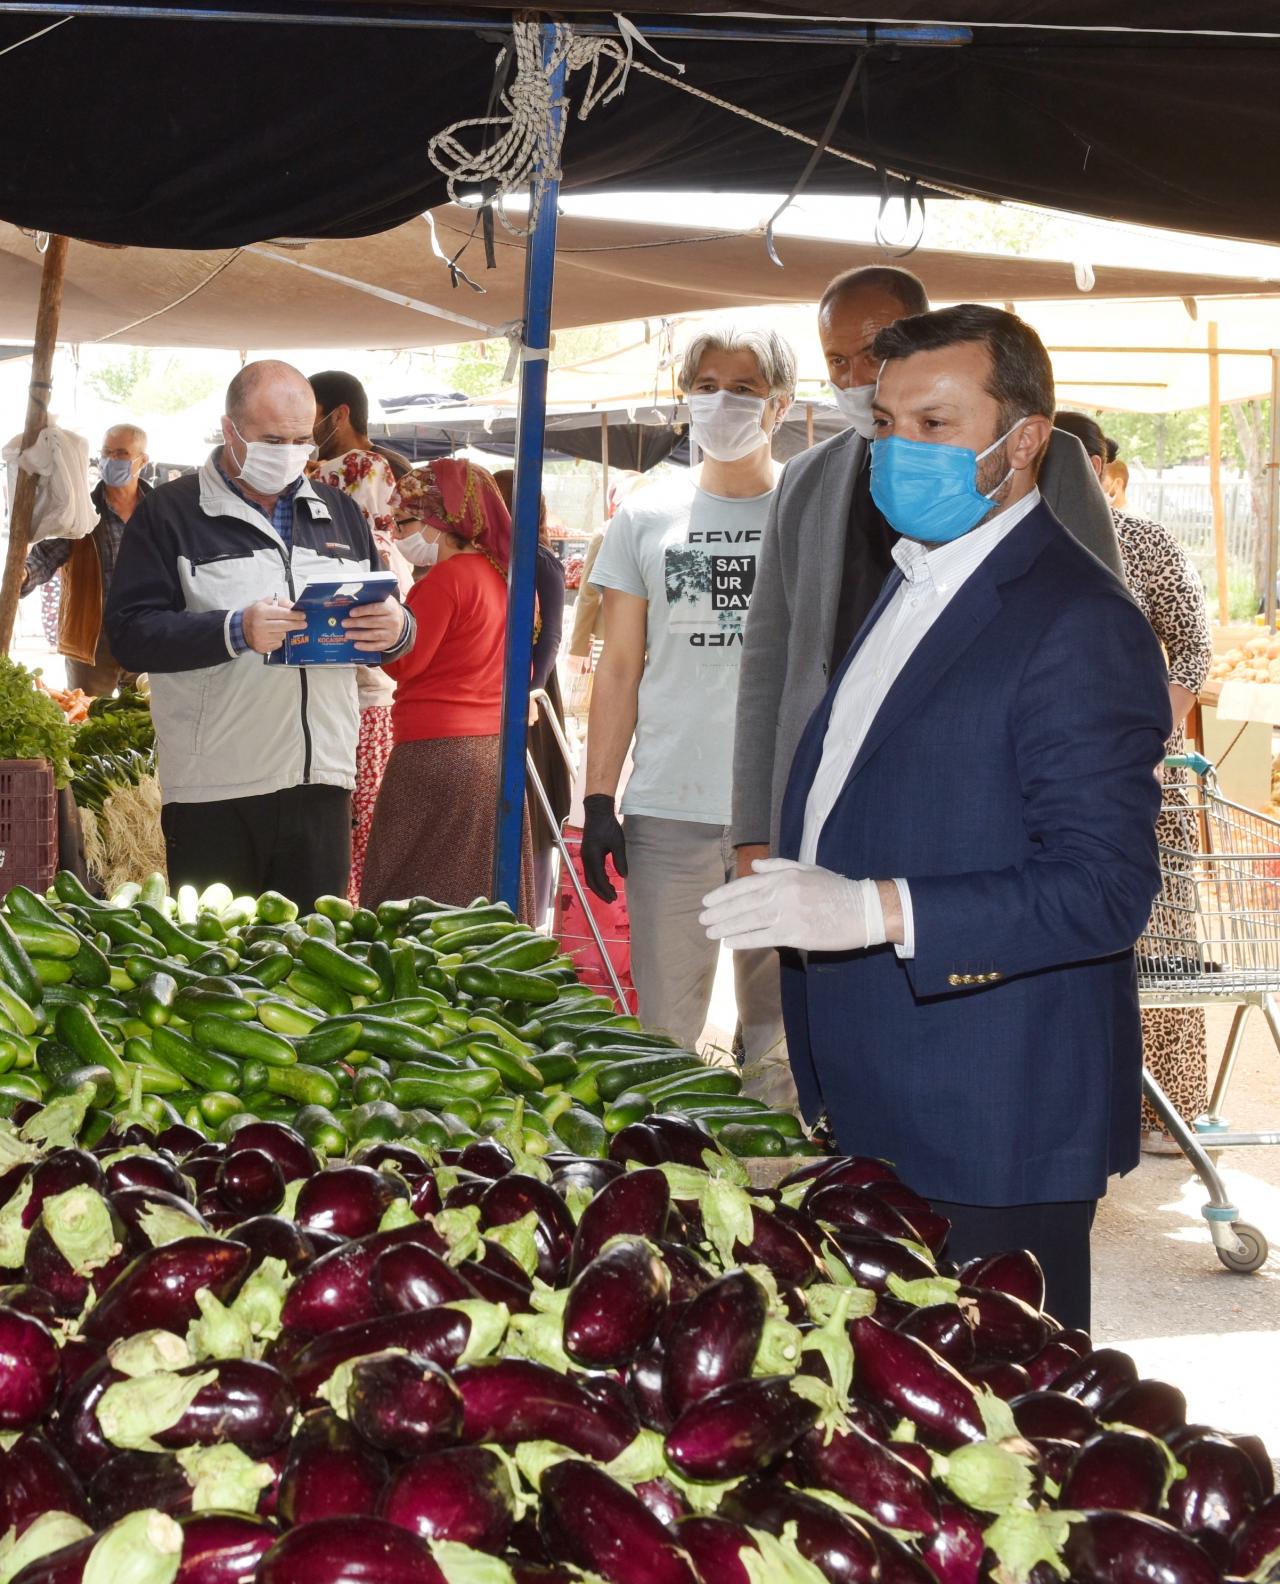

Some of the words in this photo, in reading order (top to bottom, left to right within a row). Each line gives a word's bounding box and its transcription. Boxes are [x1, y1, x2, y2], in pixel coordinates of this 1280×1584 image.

[716, 558, 751, 572] SAT
[716, 576, 742, 590] UR
[716, 594, 752, 608] DAY
